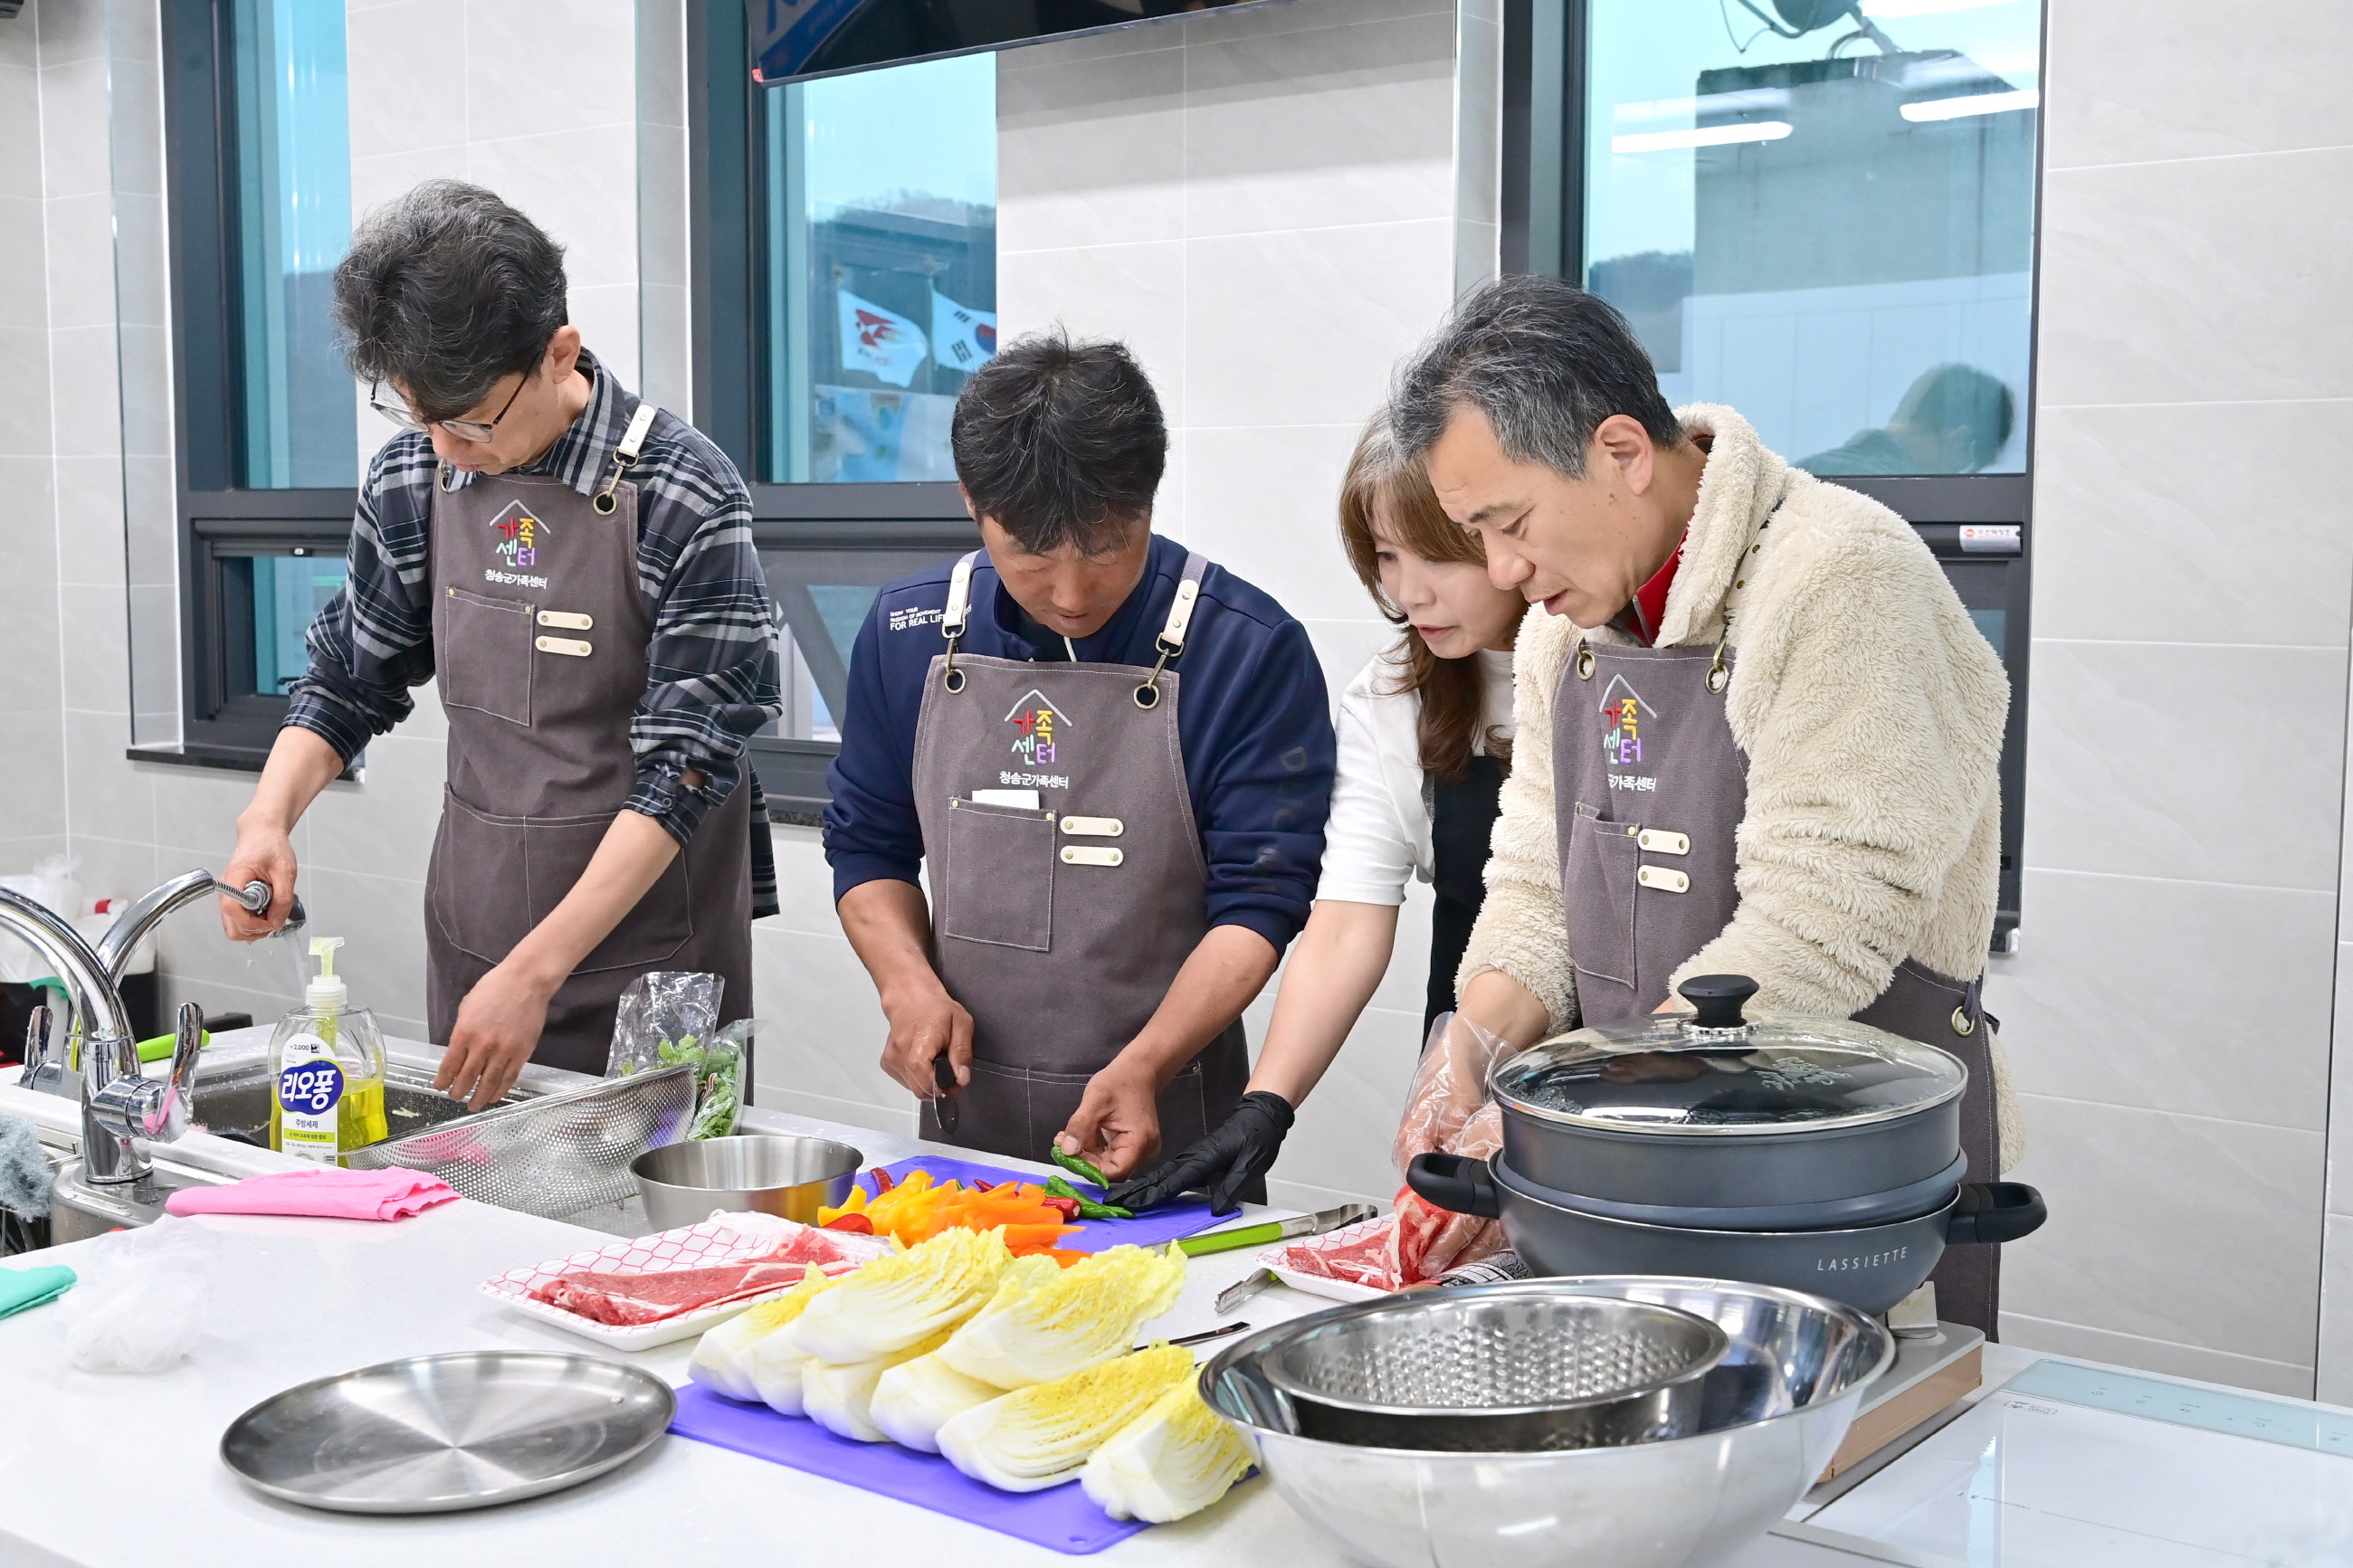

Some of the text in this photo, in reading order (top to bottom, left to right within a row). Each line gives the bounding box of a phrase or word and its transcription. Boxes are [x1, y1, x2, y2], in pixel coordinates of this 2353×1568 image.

[498, 518, 535, 549] 가족
[496, 538, 536, 566] 센터
[485, 568, 548, 589] 청송군가족센터
[890, 621, 907, 631] FOR
[909, 616, 929, 628] REAL
[1013, 710, 1053, 746] 가족
[1604, 698, 1638, 740] 가족
[1011, 734, 1056, 765] 센터
[1604, 727, 1642, 765] 센터
[999, 771, 1069, 790] 청송군가족센터
[281, 1069, 337, 1110] 리오퐁
[295, 1118, 319, 1129] 주방세제
[1817, 1246, 1908, 1271] LASSIETTE
